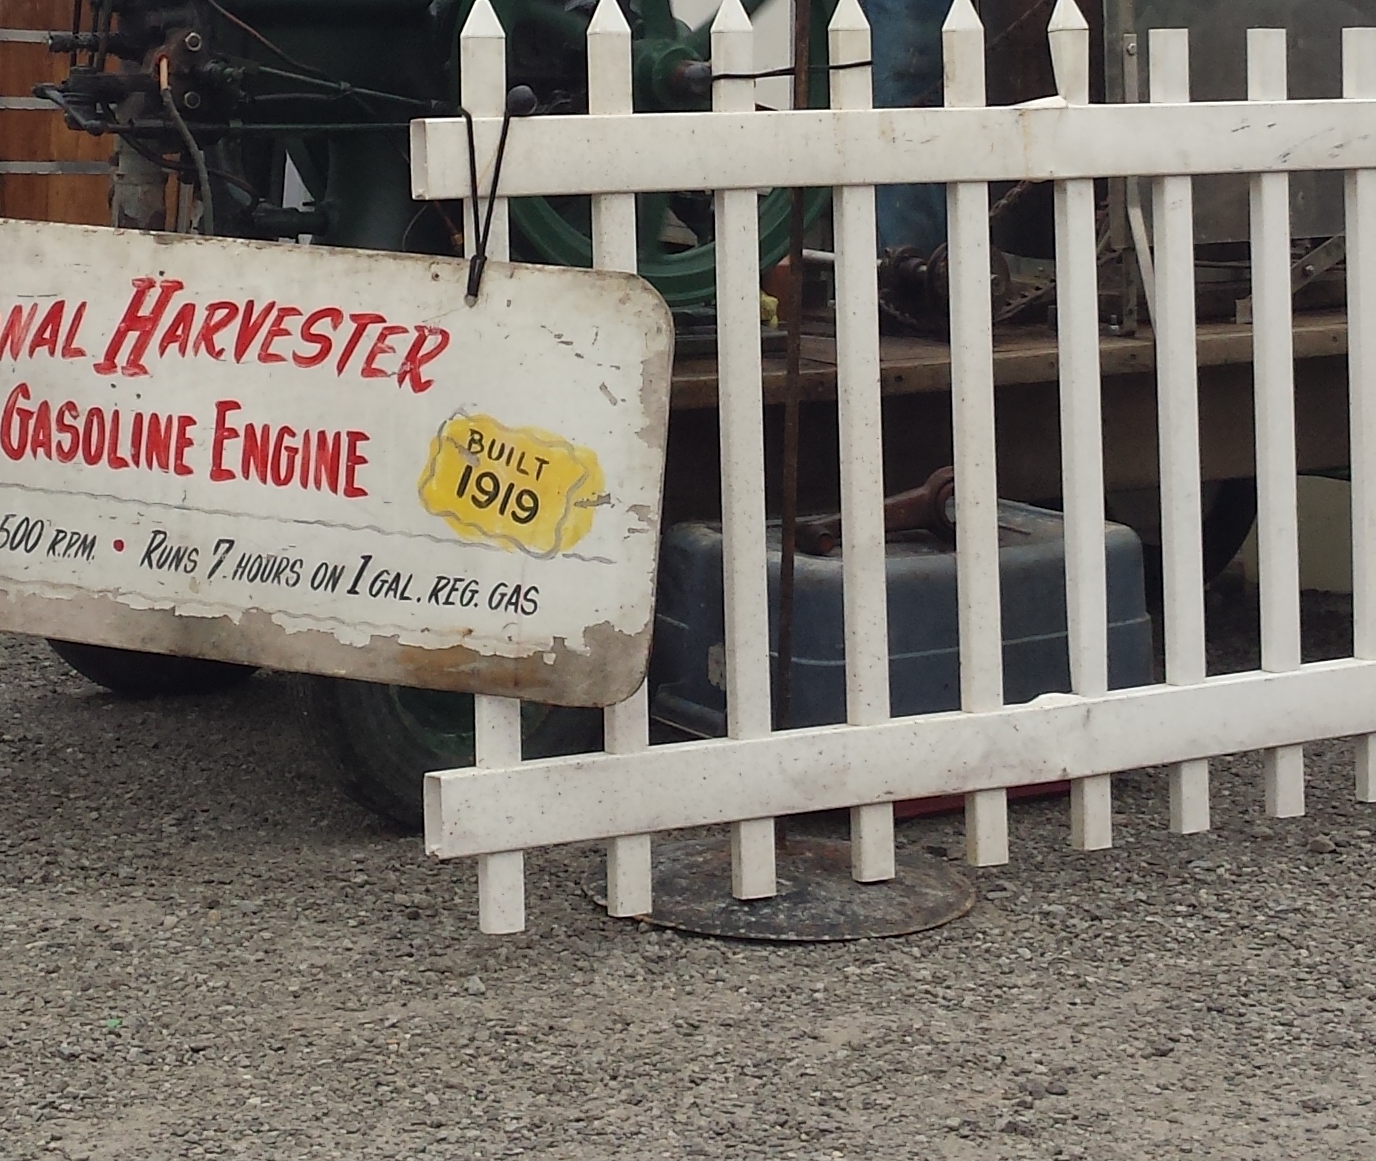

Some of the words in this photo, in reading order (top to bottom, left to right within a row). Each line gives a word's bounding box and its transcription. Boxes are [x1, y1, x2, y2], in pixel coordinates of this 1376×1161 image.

[92, 276, 451, 394] HARVESTER
[0, 382, 197, 476] GASOLINE
[209, 400, 371, 498] ENGINE
[465, 428, 550, 482] BUILT
[456, 465, 540, 525] 1919
[139, 529, 200, 575] RUNS
[206, 538, 235, 579] 7
[232, 553, 304, 588] HOURS
[310, 561, 345, 594] ON
[346, 554, 373, 596] 1
[369, 570, 422, 604] GAL.
[428, 576, 479, 608] REG.
[487, 582, 540, 616] GAS
